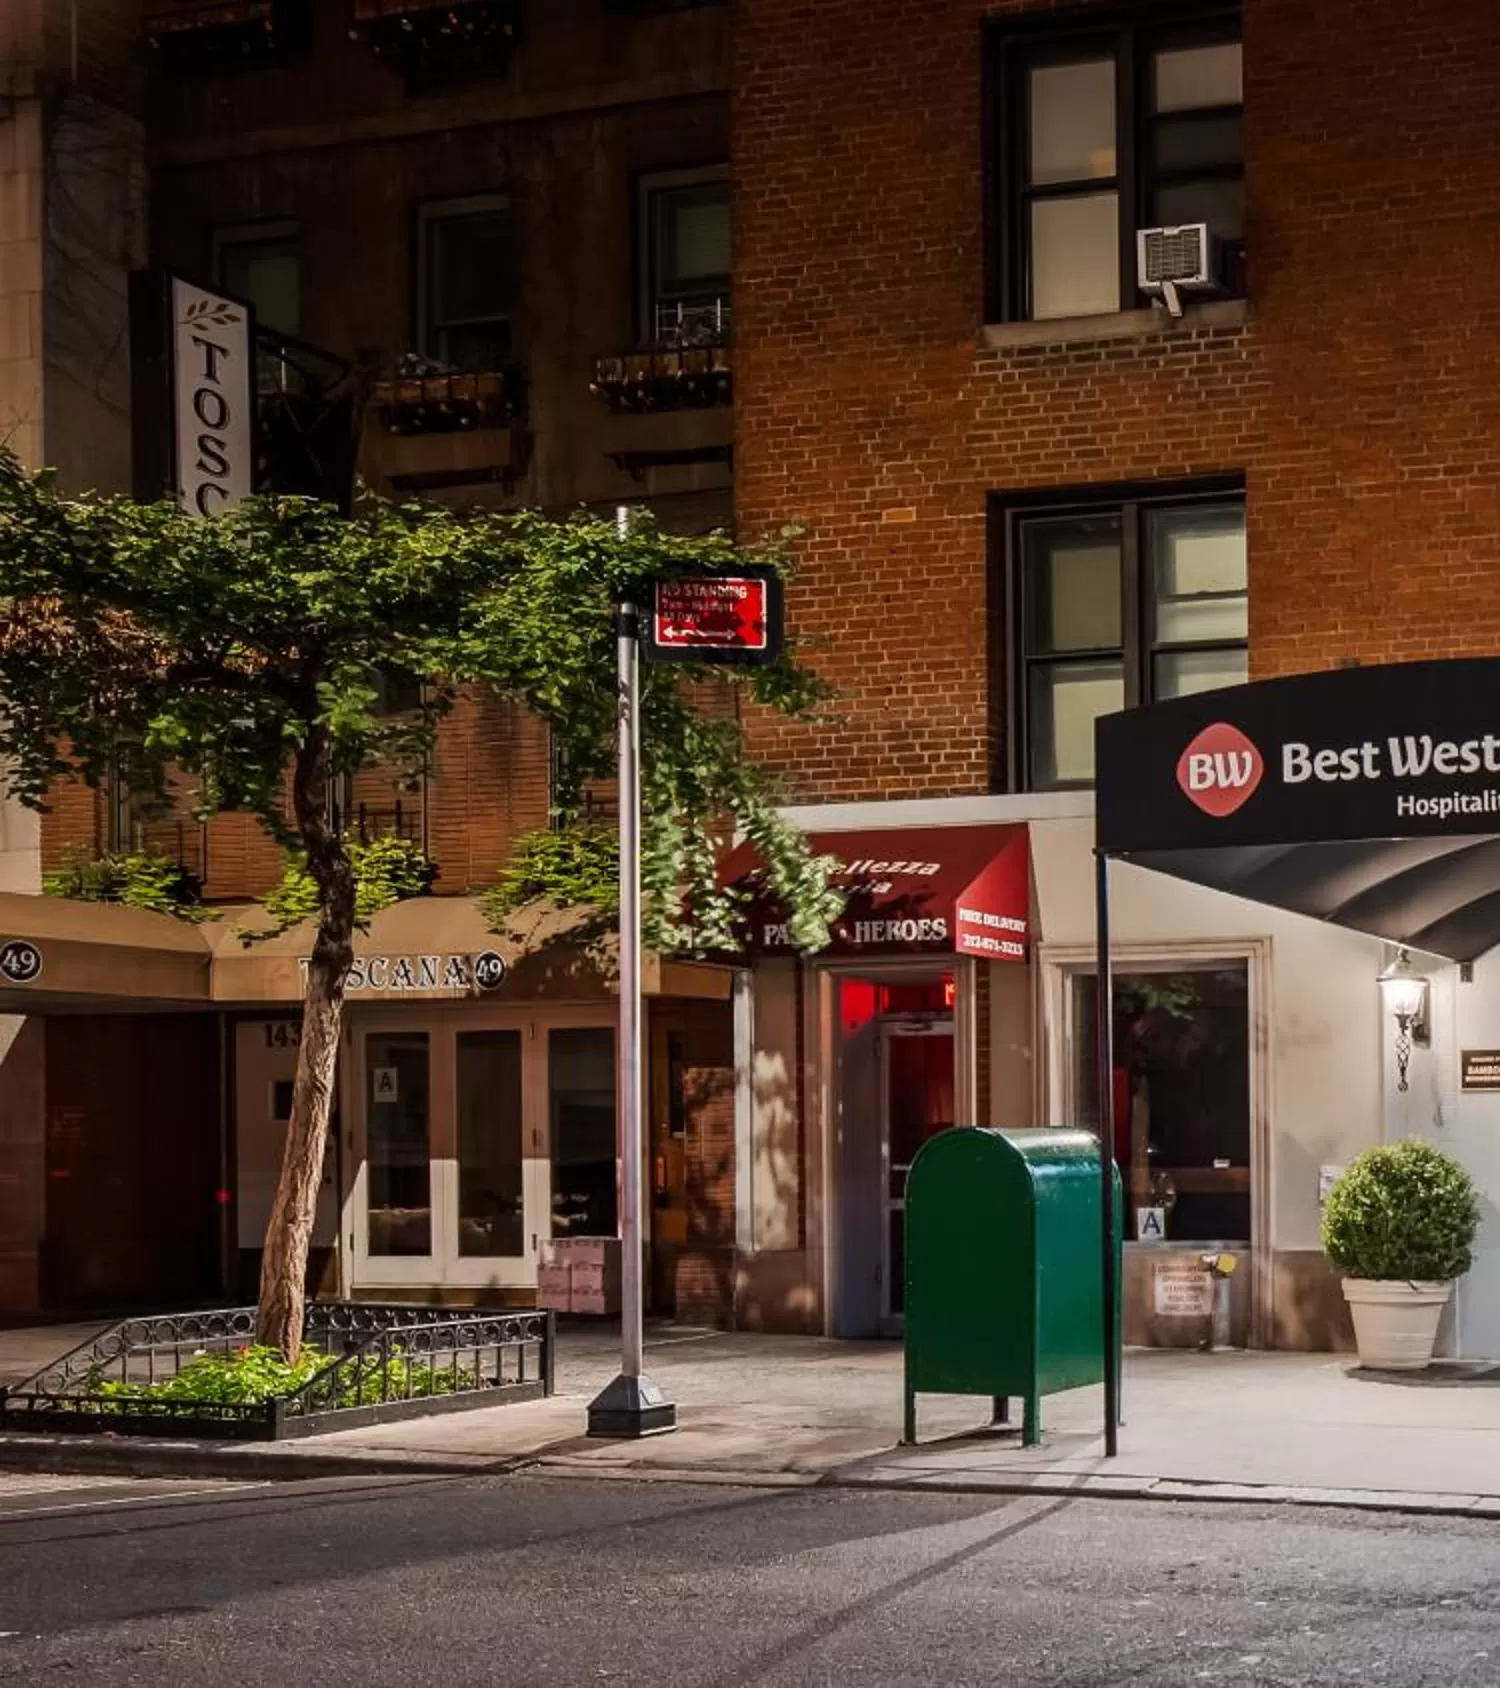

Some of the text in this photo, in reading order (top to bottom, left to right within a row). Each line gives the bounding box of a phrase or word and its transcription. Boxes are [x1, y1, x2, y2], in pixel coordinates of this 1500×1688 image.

[192, 335, 230, 519] TOSC
[1188, 751, 1252, 790] BW
[1281, 742, 1381, 783] Best
[853, 918, 948, 943] HEROES
[1, 949, 37, 975] 49
[476, 958, 503, 982] 49
[378, 1072, 394, 1093] A
[1141, 1210, 1162, 1235] A
